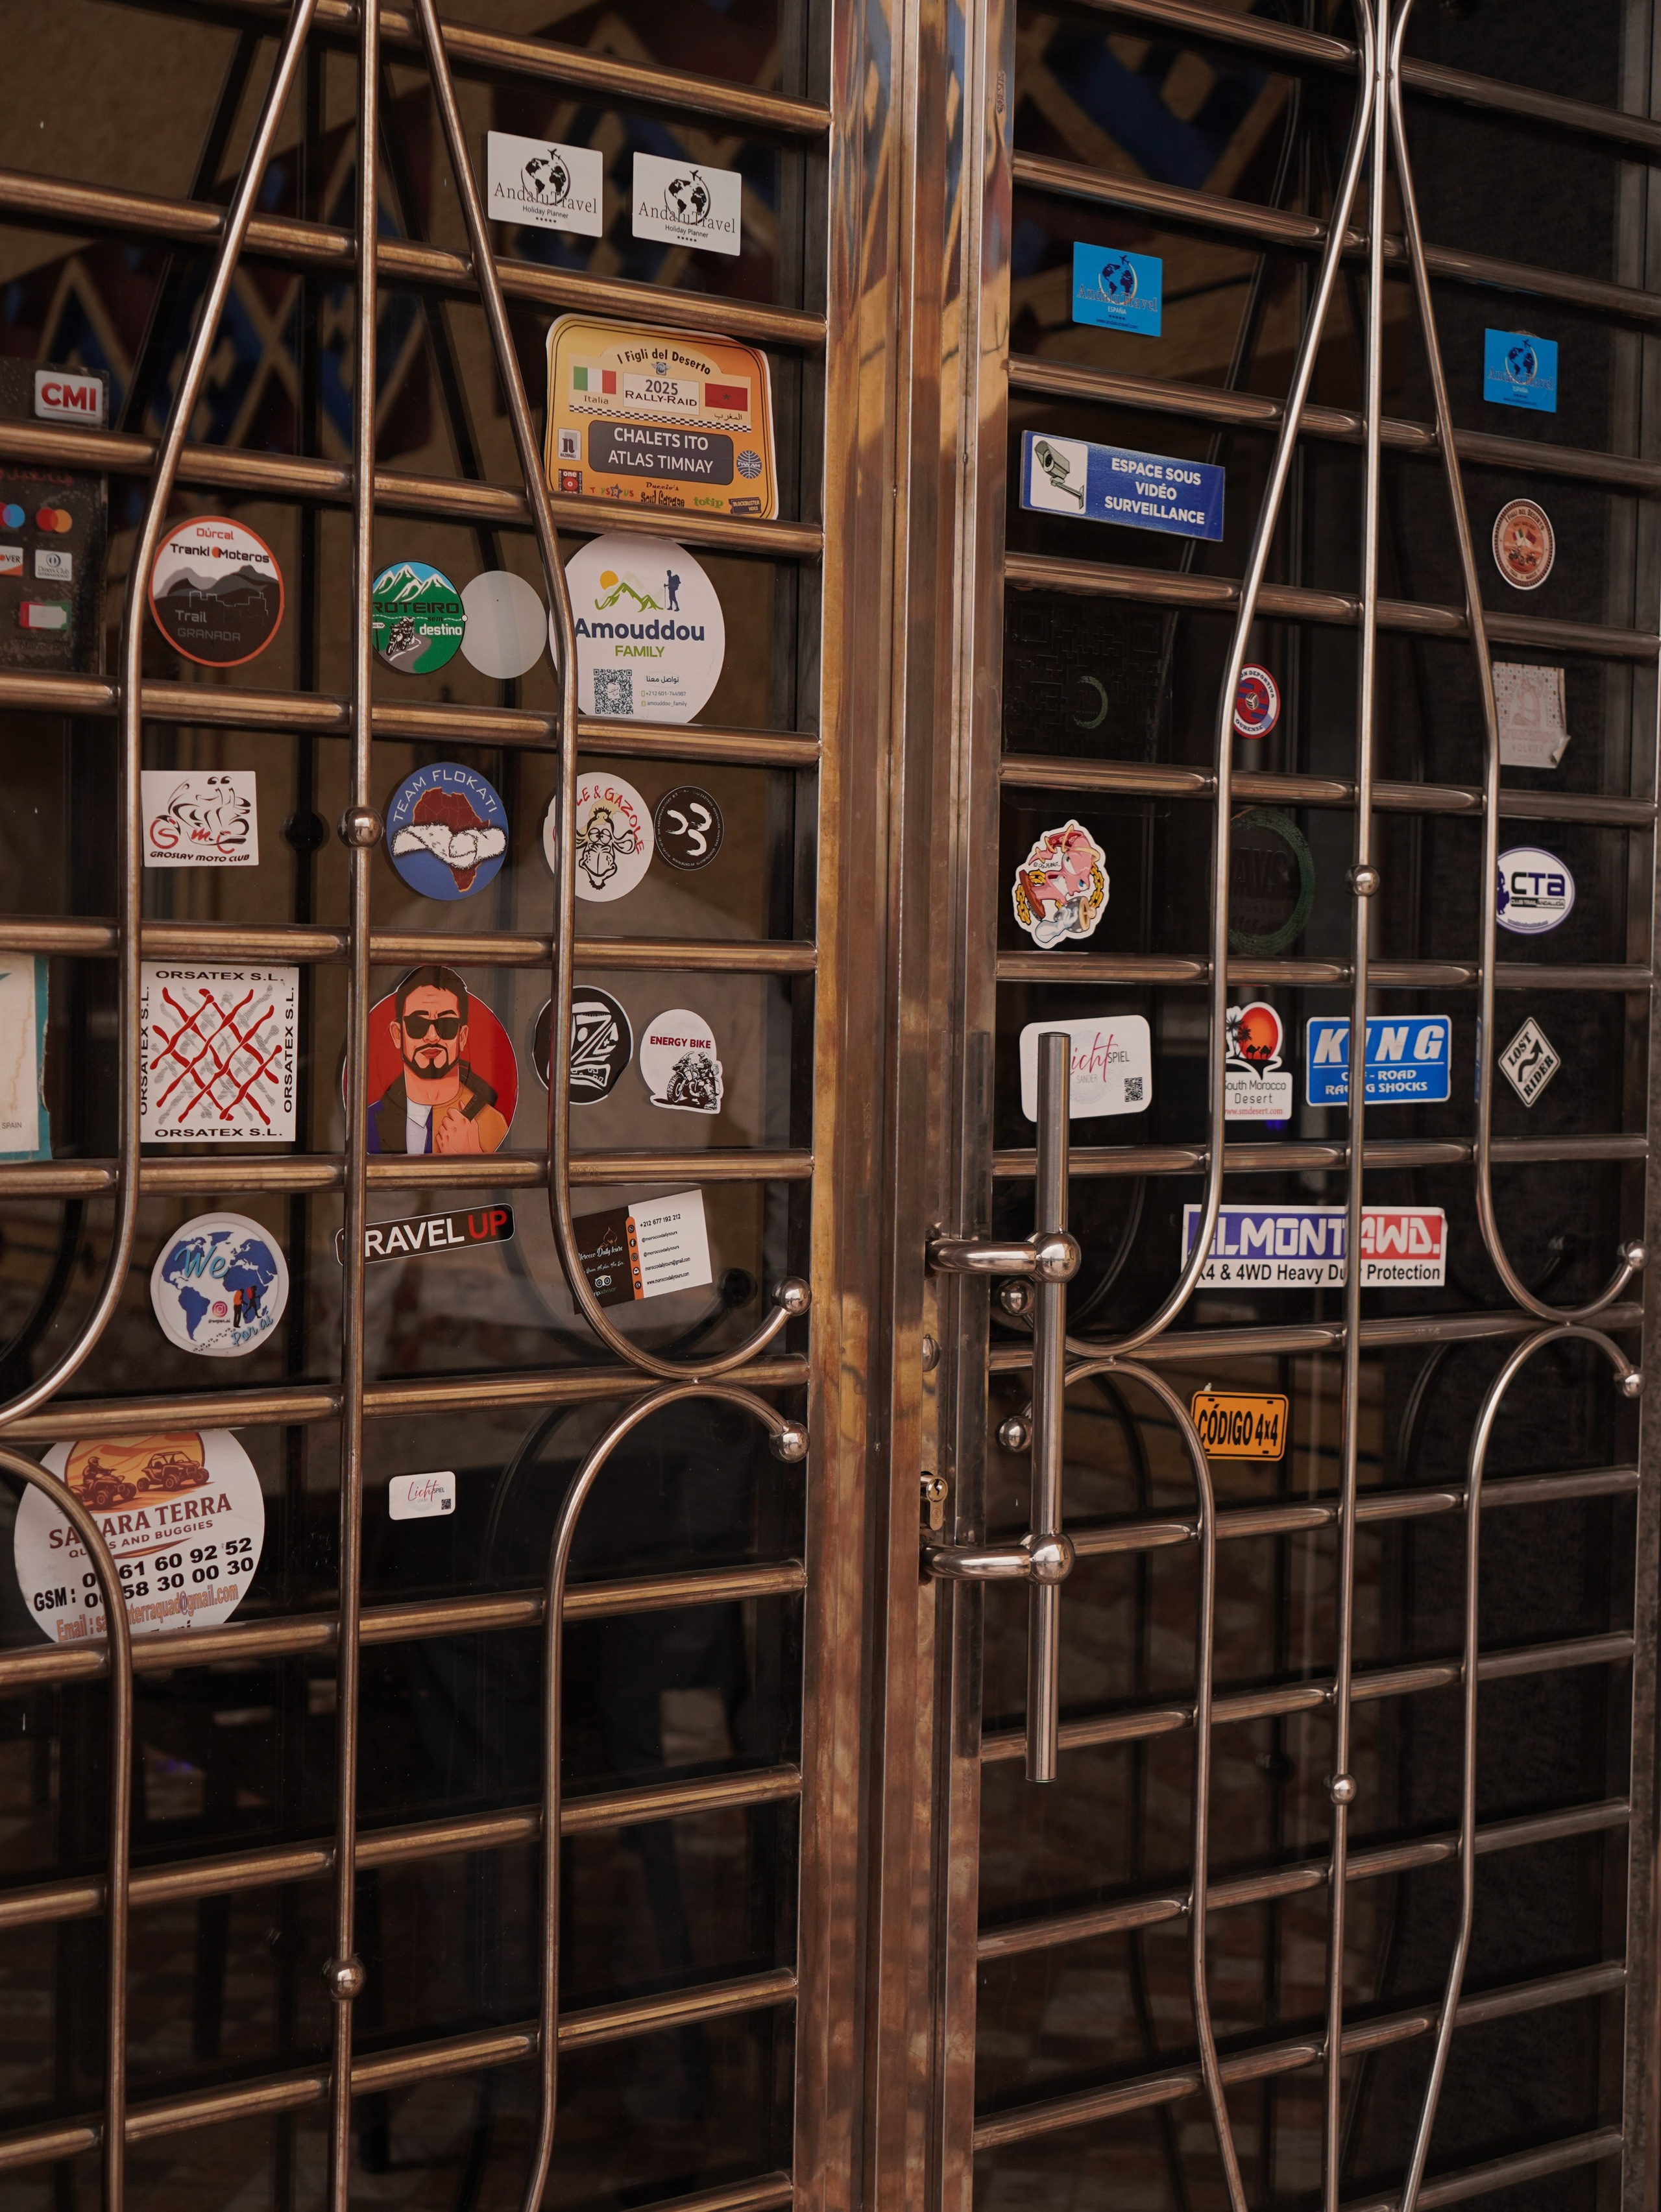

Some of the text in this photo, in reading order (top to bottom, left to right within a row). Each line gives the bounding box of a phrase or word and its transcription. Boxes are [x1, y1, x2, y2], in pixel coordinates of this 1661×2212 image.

[522, 205, 568, 219] Holiday Planner
[665, 224, 709, 238] Holiday Planner
[1108, 306, 1126, 315] ESPAÑA
[617, 348, 710, 374] I Figli del Deserto
[645, 379, 678, 396] 2025
[41, 382, 96, 412] CMI
[584, 395, 609, 405] Italia
[625, 390, 697, 407] RALLY-RAID
[714, 413, 742, 422] المغرب
[614, 427, 709, 451] CHALETS ITO
[608, 450, 713, 474] ATLAS TIMNAY
[1111, 457, 1202, 485] ESPACE SOUS
[1135, 481, 1177, 500] VIDÉO
[693, 497, 723, 508] totip
[732, 498, 761, 508] BLOCKBUSTER
[1104, 496, 1205, 525] SURVEILLANCE
[197, 527, 234, 540] Dúrcal
[219, 550, 270, 563] Moteros
[175, 610, 207, 623] Trail
[372, 602, 459, 614] ROTEIRO
[178, 628, 241, 642] GRANADA
[420, 624, 462, 636] destino
[576, 618, 705, 641] Amouddou
[615, 645, 665, 657] FAMILY
[1249, 670, 1275, 699] DEPORTIVA
[1235, 719, 1264, 732] OURENSE
[393, 769, 497, 821] TEAM FLOKATI
[594, 786, 644, 855] & GAZOLE
[150, 851, 194, 860] GROSLAY
[156, 970, 284, 981] ORSATEX S.L.
[141, 986, 149, 1020] S.L.
[284, 987, 294, 1112] ORSATEX S.L.
[650, 1036, 711, 1049] ENERGY BIKE
[1507, 1031, 1532, 1066] LOST
[1076, 1074, 1097, 1084] SANDER
[1378, 1070, 1416, 1080] ROAD
[1523, 1055, 1554, 1098] RIDER
[1250, 1079, 1286, 1090] Morocco
[1325, 1081, 1428, 1095] RACG SHOCKS
[1235, 1093, 1272, 1103] Desert
[155, 1129, 243, 1137] ORSATEX
[365, 1210, 507, 1257] RAVEL UP
[175, 1245, 230, 1279] We
[1220, 1264, 1231, 1280] &
[1237, 1264, 1272, 1280] 4WD
[1278, 1264, 1323, 1284] Heavy
[1367, 1264, 1440, 1280] Protection
[594, 1287, 617, 1297] ripadvisor
[231, 1326, 258, 1347] Por
[1198, 1404, 1253, 1445] CÓDIGO
[49, 1493, 232, 1549] SAARA TERRA
[69, 1520, 213, 1558] QUS AND BUGGIES
[154, 1553, 182, 1571] 60
[190, 1545, 217, 1563] 92
[225, 1537, 252, 1556] 52
[157, 1573, 184, 1591] 30
[191, 1565, 219, 1583] 00
[226, 1557, 254, 1576] 30
[34, 1587, 67, 1612] GSM
[56, 1613, 88, 1642] Email
